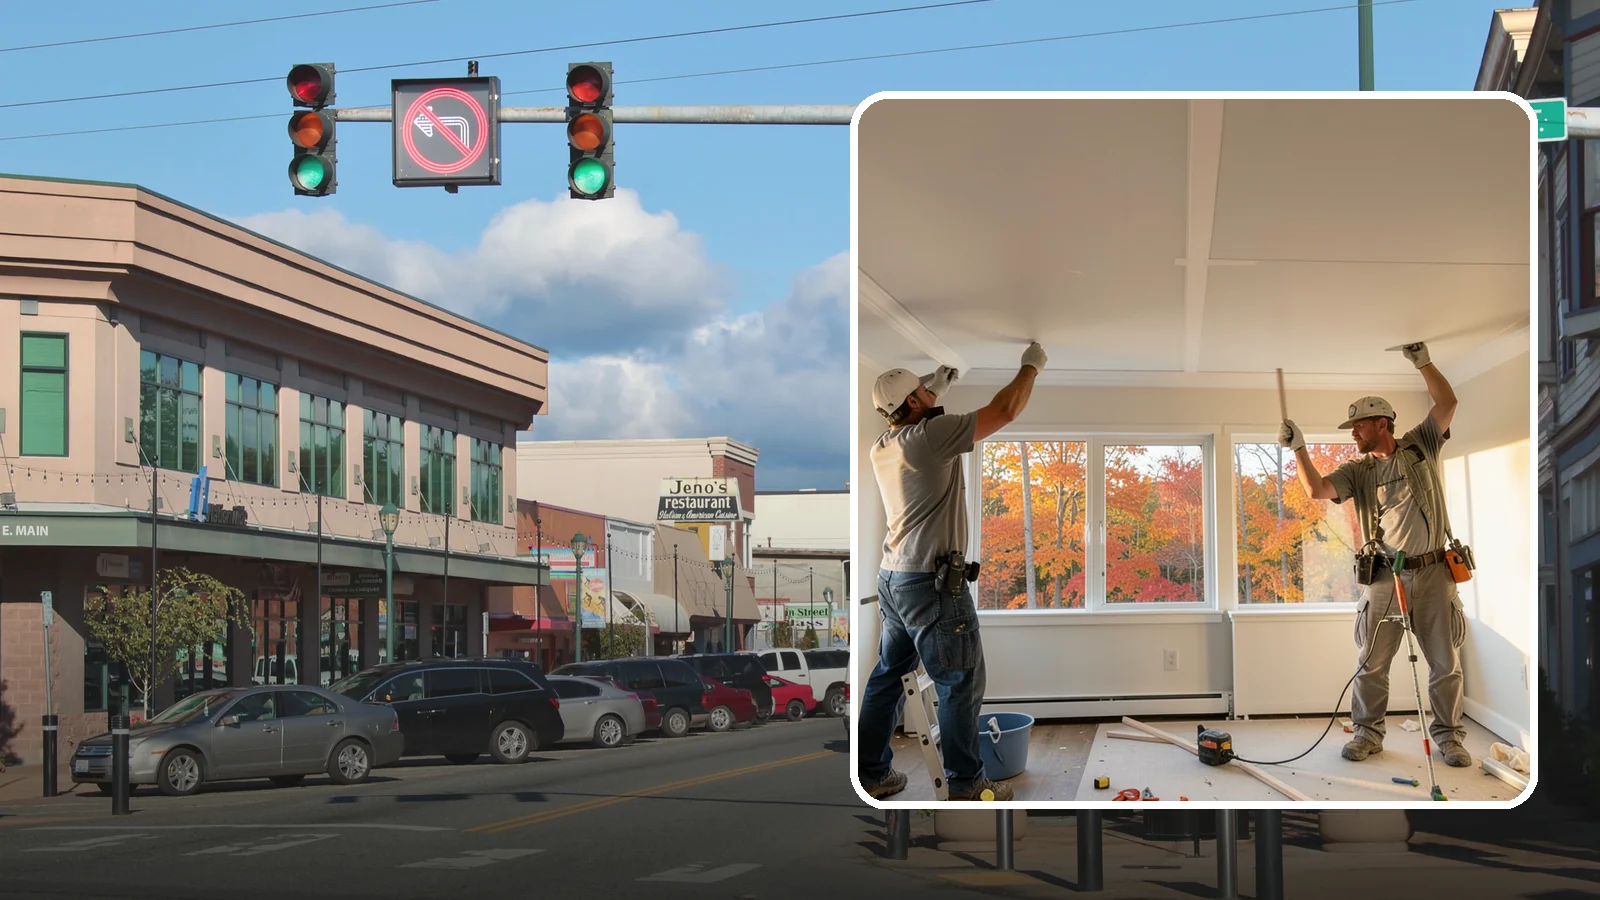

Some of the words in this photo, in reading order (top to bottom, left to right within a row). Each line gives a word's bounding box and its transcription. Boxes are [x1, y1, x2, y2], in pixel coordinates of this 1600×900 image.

[670, 480, 727, 494] Jeno's
[665, 496, 731, 509] restaurant
[658, 510, 681, 520] Italian
[686, 509, 714, 519] American
[715, 509, 737, 519] Cuisine
[2, 525, 12, 536] E.
[15, 525, 49, 536] MAIN
[797, 607, 829, 616] Street
[790, 619, 824, 627] lass
